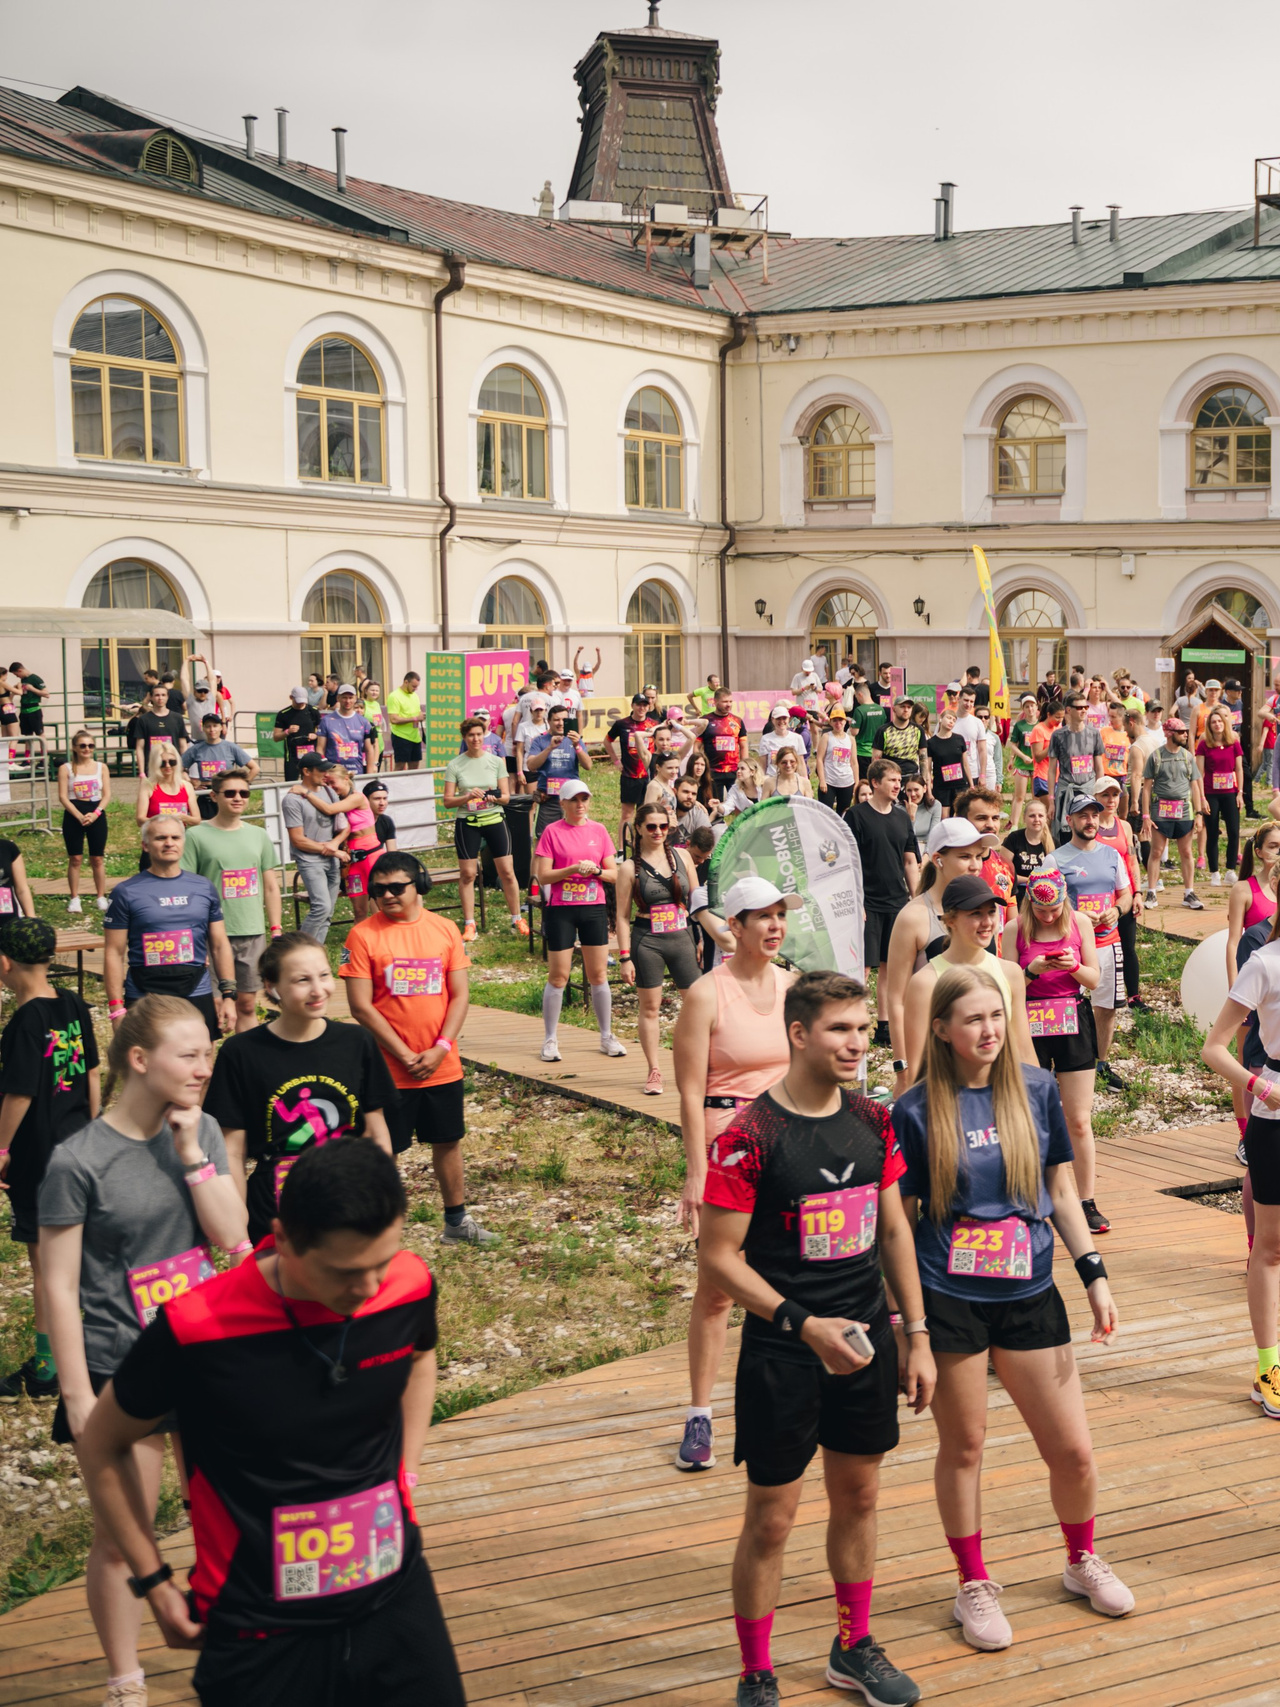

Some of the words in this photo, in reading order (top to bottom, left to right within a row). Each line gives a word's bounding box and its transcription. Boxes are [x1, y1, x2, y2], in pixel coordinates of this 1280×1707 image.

[430, 656, 461, 664] RUTS
[430, 669, 461, 677] RUTS
[469, 662, 525, 697] RUTS
[430, 682, 461, 690] RUTS
[430, 695, 461, 703] RUTS
[430, 708, 461, 716] RUTS
[734, 700, 771, 718] UTS
[430, 721, 461, 729] RUTS
[430, 734, 461, 742] RUTS
[224, 877, 247, 888] 108
[562, 883, 586, 893] 020
[1079, 901, 1101, 913] 293
[652, 912, 675, 923] 259
[145, 940, 175, 953] 299
[393, 968, 427, 981] 055
[1029, 1009, 1056, 1023] 214
[276, 1075, 317, 1095] URBAN
[318, 1075, 348, 1096] TRAIL
[803, 1210, 845, 1235] 119
[952, 1229, 1003, 1251] 223
[133, 1271, 188, 1307] 102
[279, 1511, 316, 1522] RUTS
[278, 1519, 354, 1567] 105
